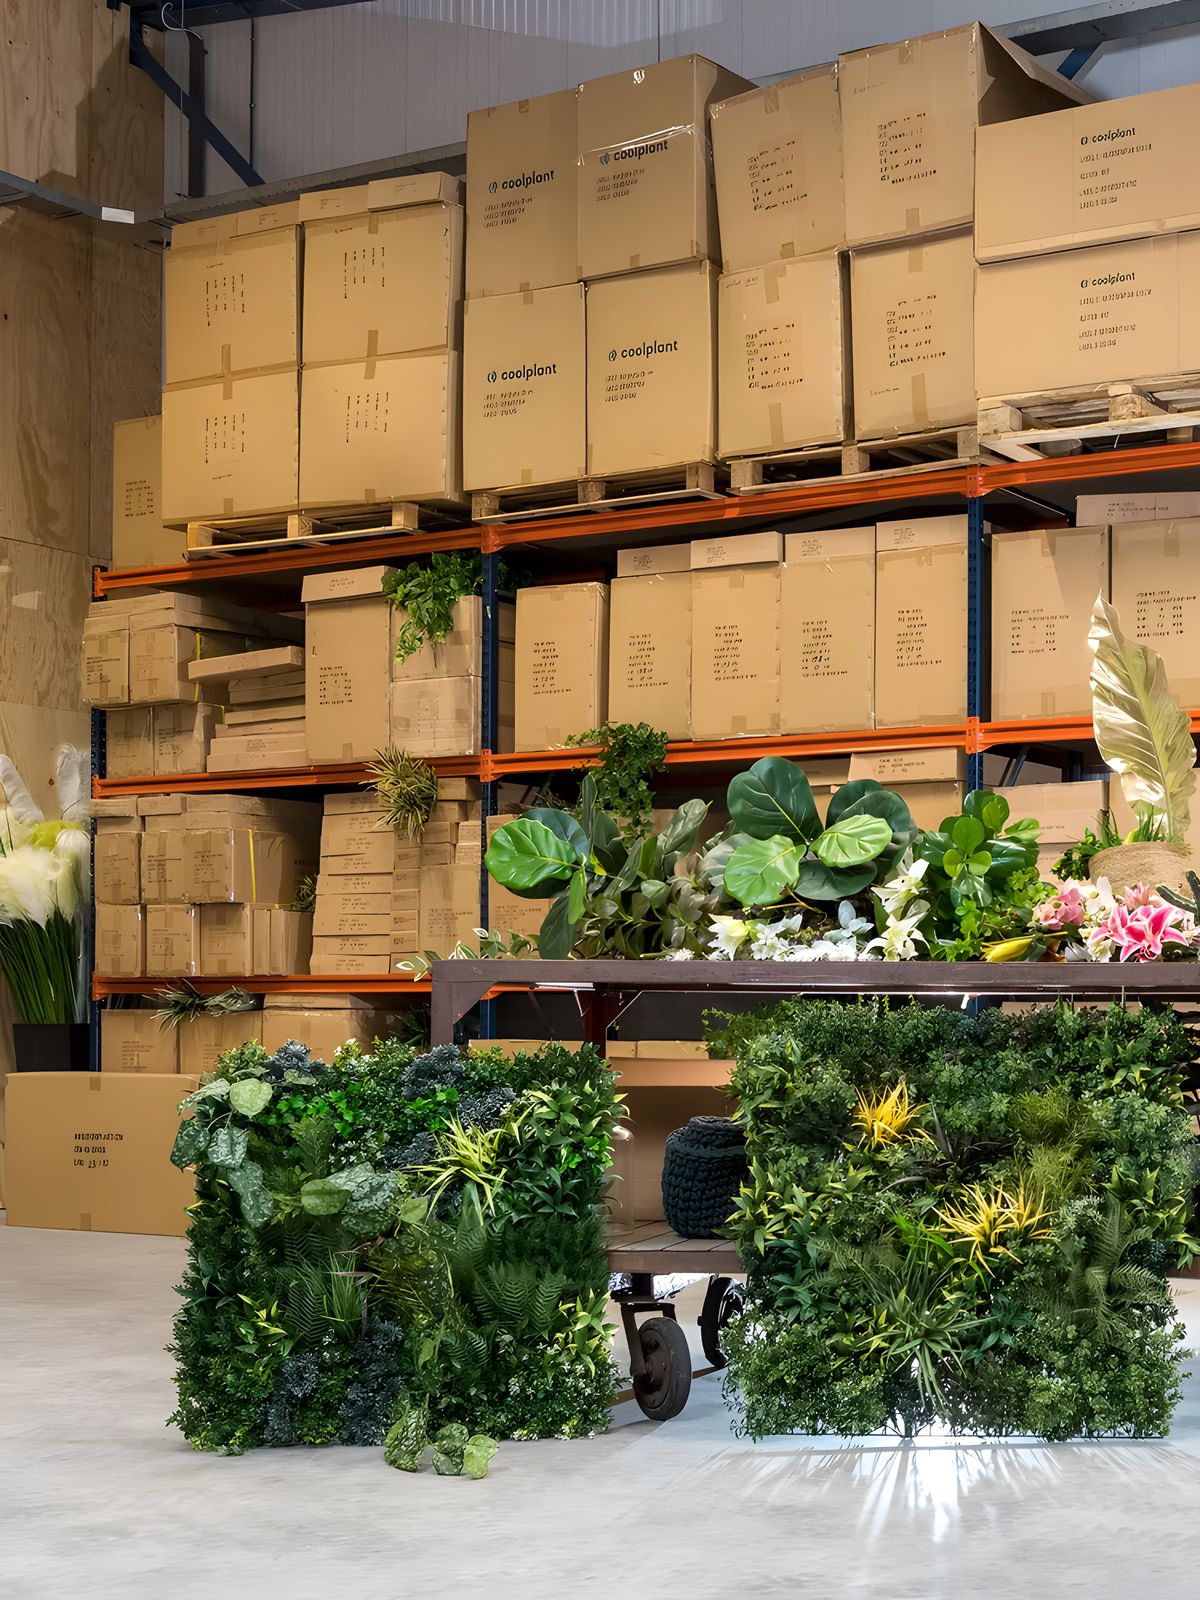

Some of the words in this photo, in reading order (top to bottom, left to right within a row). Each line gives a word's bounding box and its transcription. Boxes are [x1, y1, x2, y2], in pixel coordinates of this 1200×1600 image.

[501, 170, 555, 188] coolplant
[621, 340, 678, 358] coolplant
[501, 363, 557, 380] coolplant
